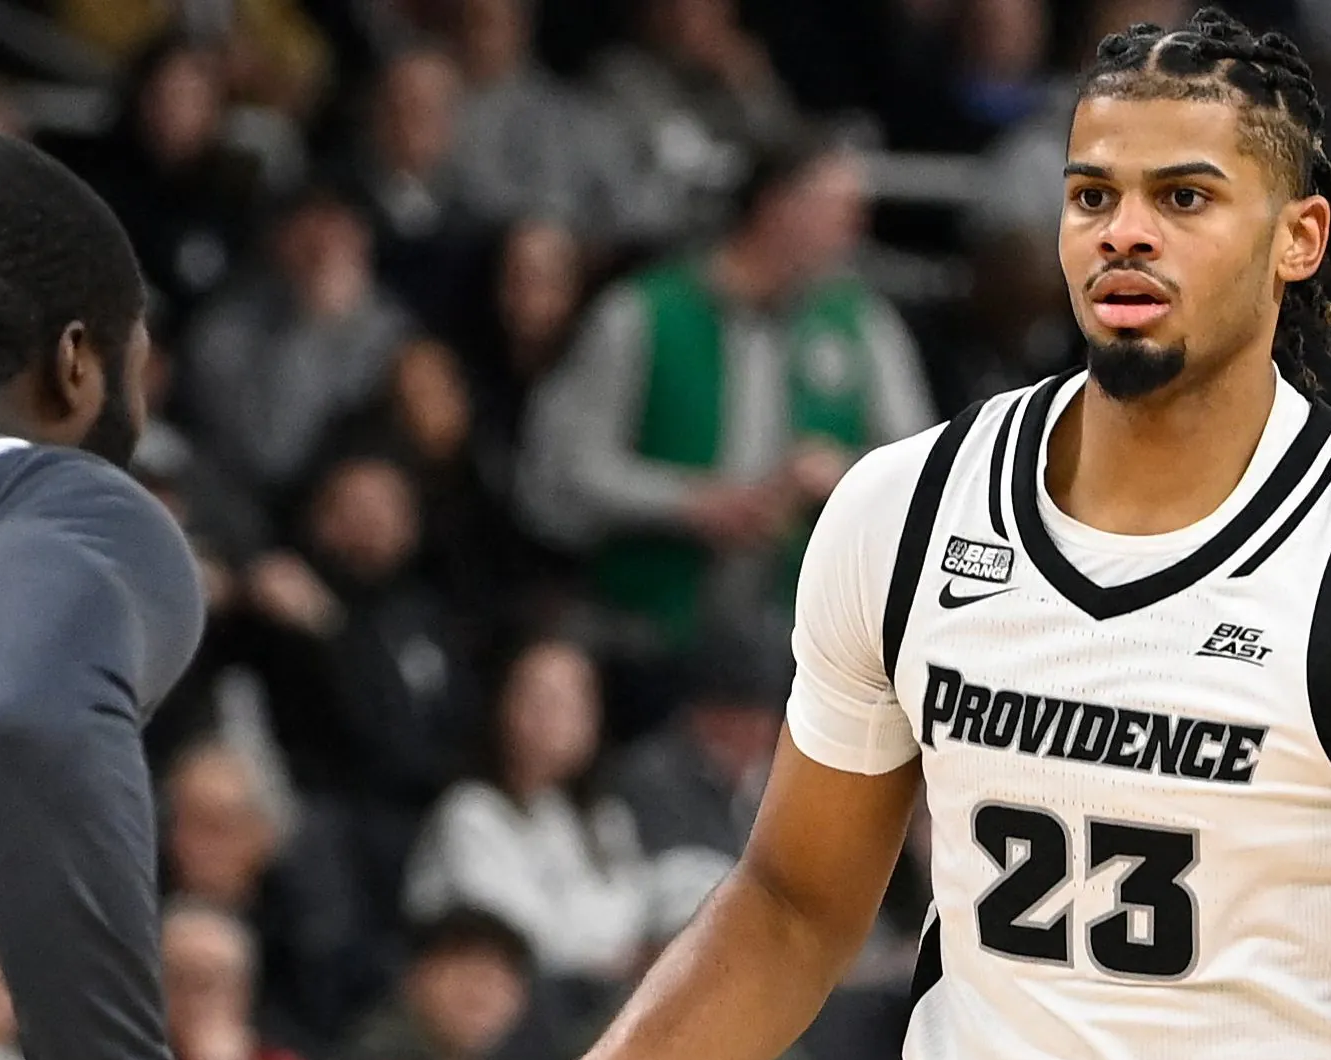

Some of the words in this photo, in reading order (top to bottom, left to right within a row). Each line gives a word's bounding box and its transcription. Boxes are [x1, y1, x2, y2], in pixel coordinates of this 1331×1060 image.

[944, 556, 1010, 580] CHANGE
[1212, 622, 1264, 643] BIG
[1201, 636, 1273, 660] EAST
[922, 664, 1269, 784] PROVIDENCE
[972, 800, 1200, 980] 23
